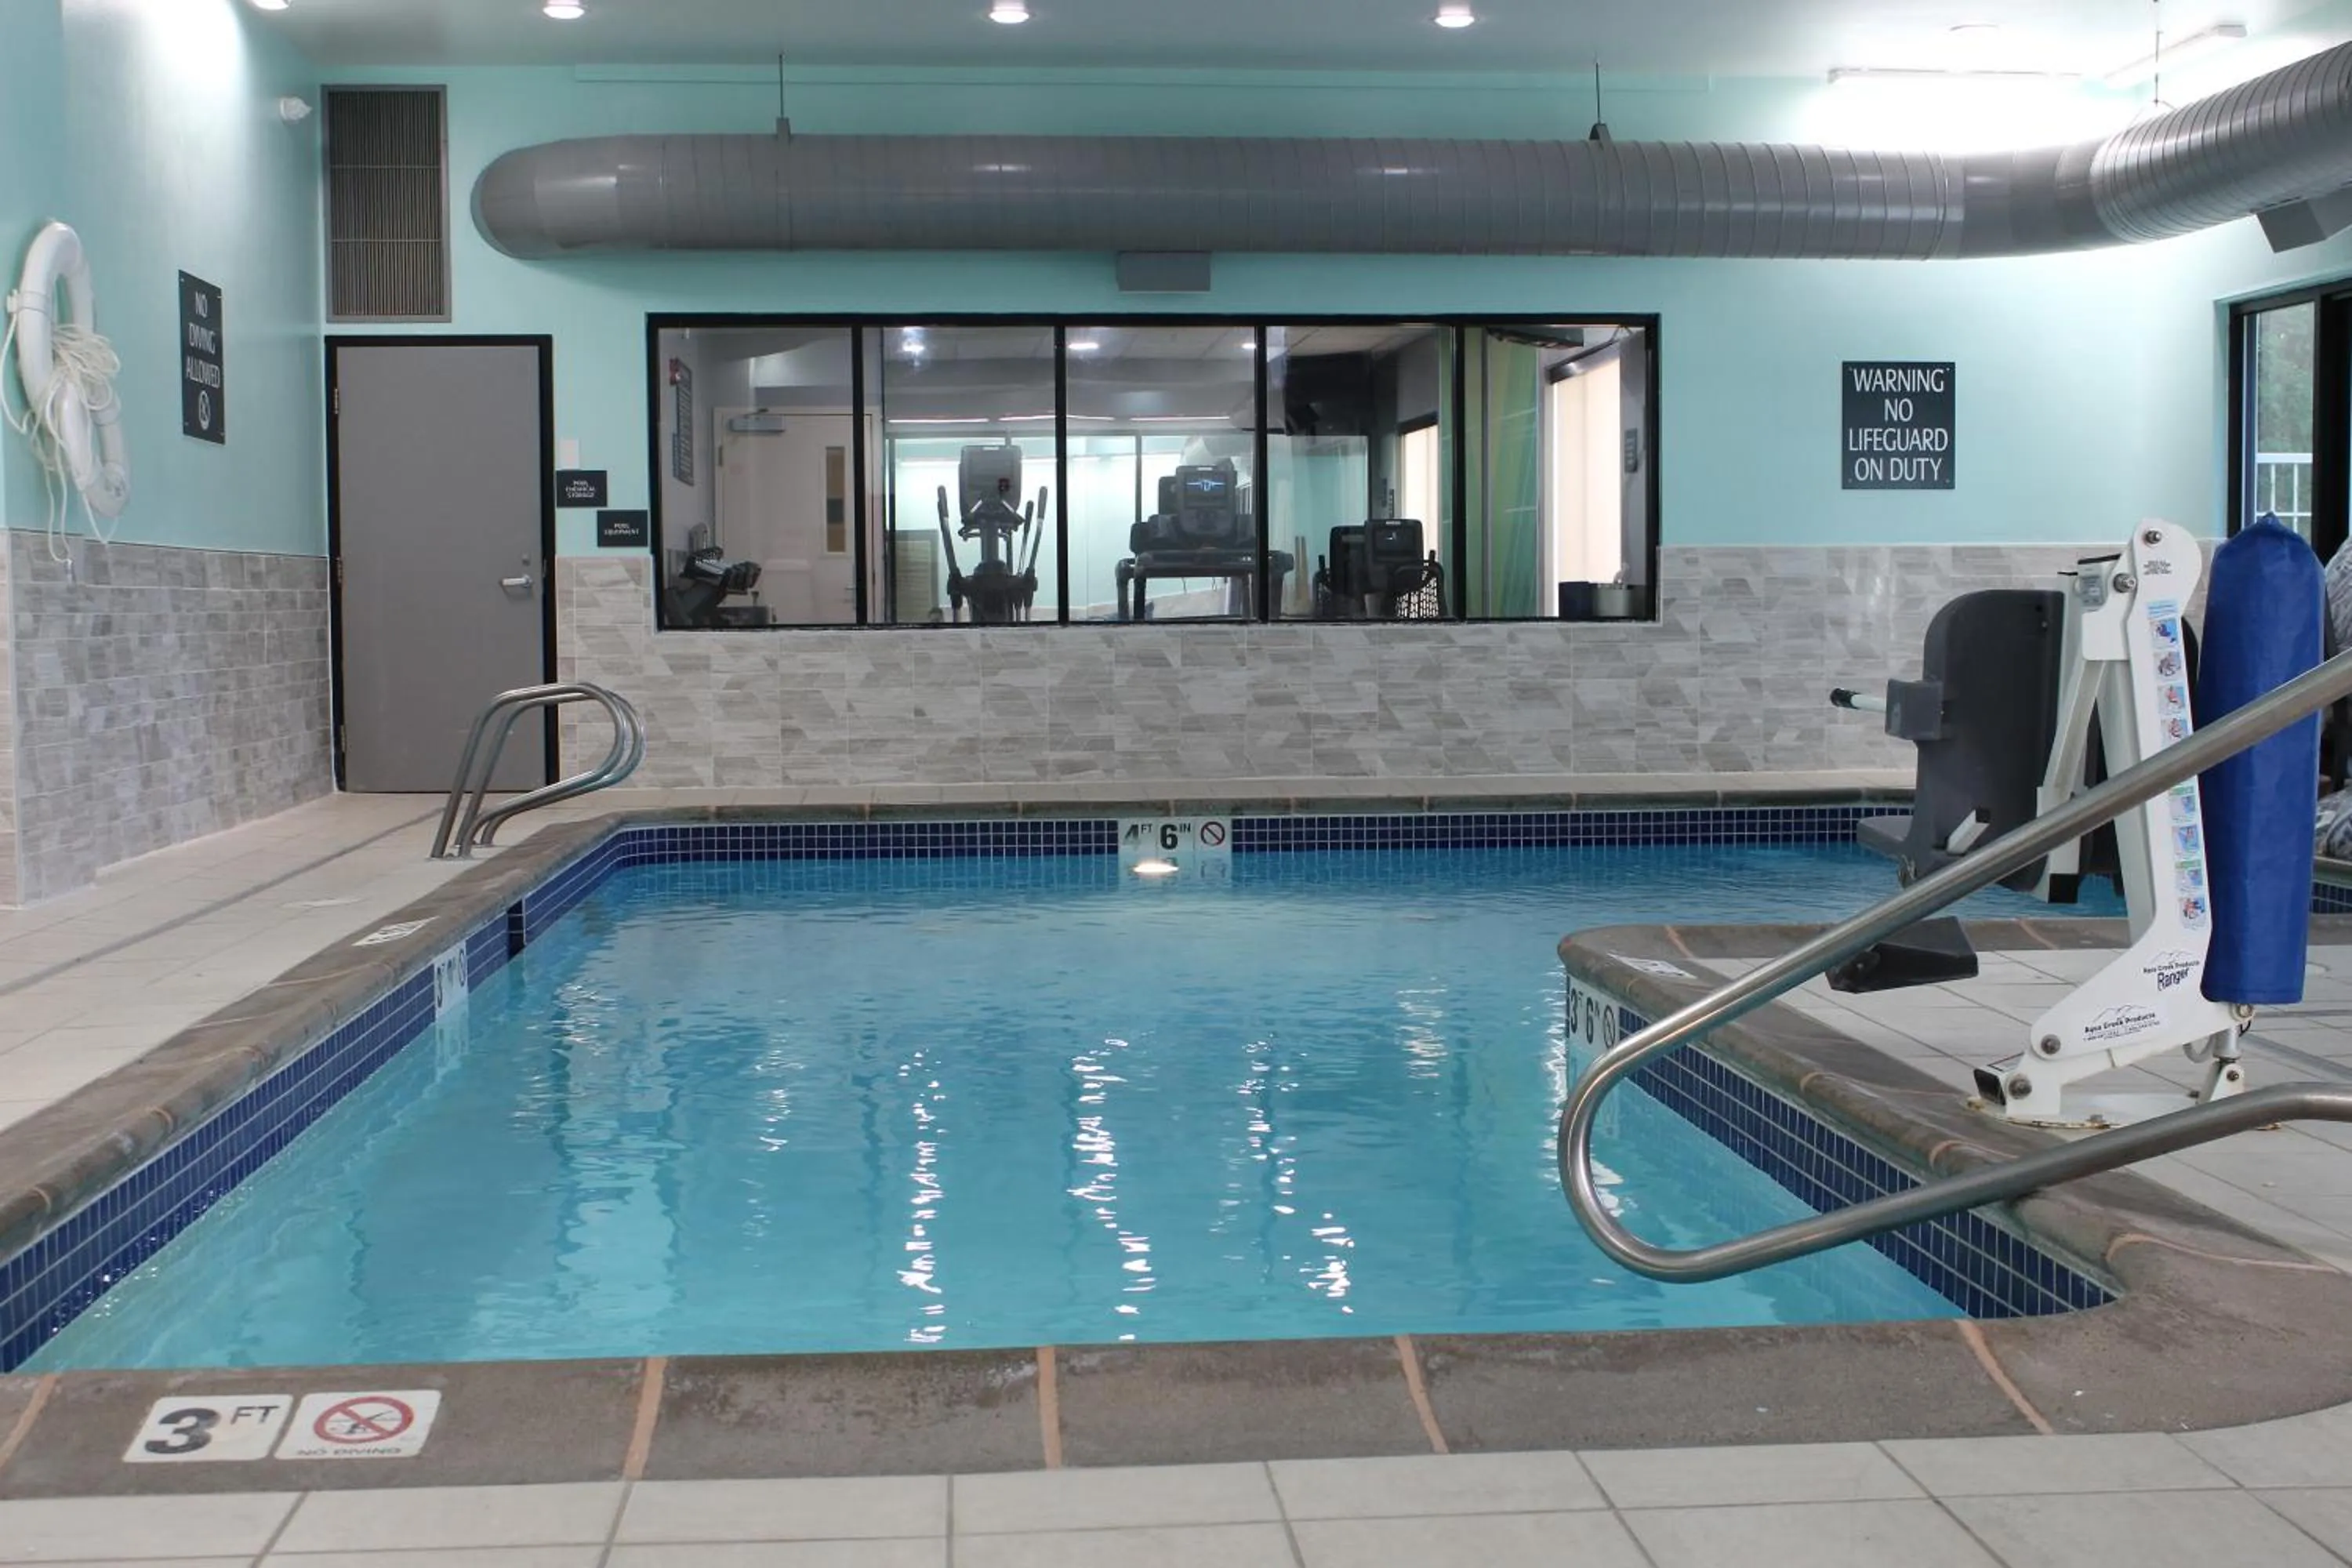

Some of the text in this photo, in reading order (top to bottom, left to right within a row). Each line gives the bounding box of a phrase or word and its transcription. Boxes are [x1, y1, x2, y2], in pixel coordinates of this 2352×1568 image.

[194, 291, 209, 318] NO
[189, 321, 216, 355] DIVING
[187, 355, 220, 389] ALLOWED
[1853, 368, 1945, 393] WARNING
[1884, 397, 1914, 423] NO
[1849, 427, 1949, 452] LIFEGUARD
[1854, 457, 1943, 481] ON DUTY
[1141, 823, 1152, 833] FT
[1160, 823, 1178, 850] 6
[1179, 822, 1191, 833] IN
[2158, 967, 2190, 992] Ranger
[1570, 987, 1594, 1045] 3 6
[143, 1405, 281, 1455] 3 FT
